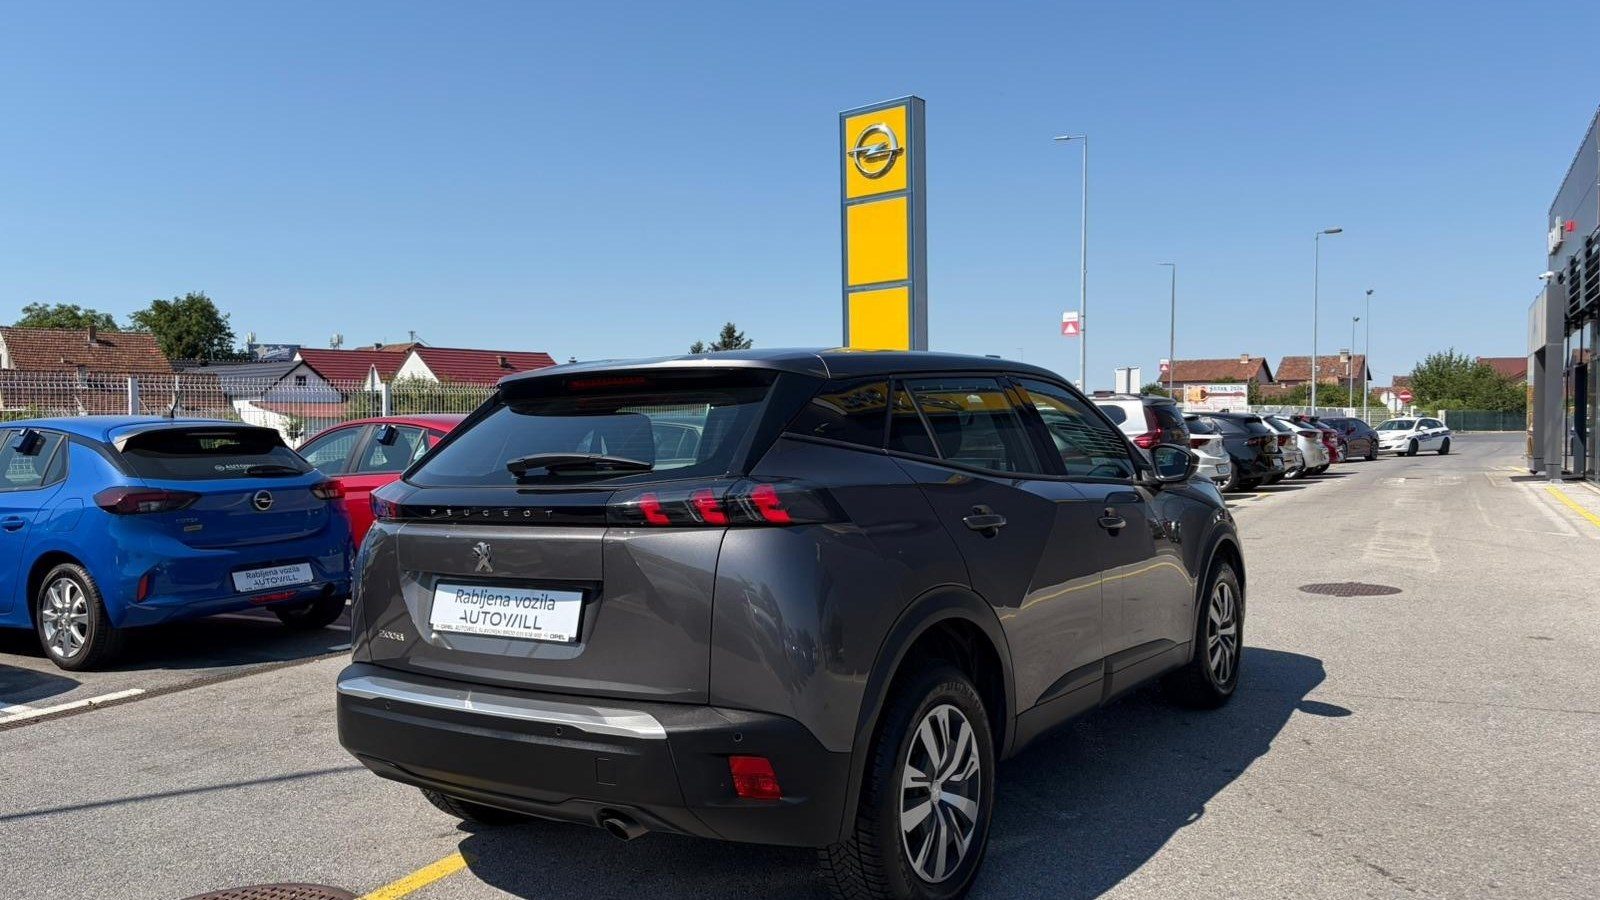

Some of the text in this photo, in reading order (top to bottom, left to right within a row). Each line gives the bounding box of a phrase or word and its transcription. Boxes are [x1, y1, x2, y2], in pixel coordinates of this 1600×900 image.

[430, 508, 553, 518] PEUGEOT
[246, 566, 300, 579] Rabljena vozila
[455, 588, 556, 611] Rabljena vozila
[459, 609, 543, 630] AUTOWILL
